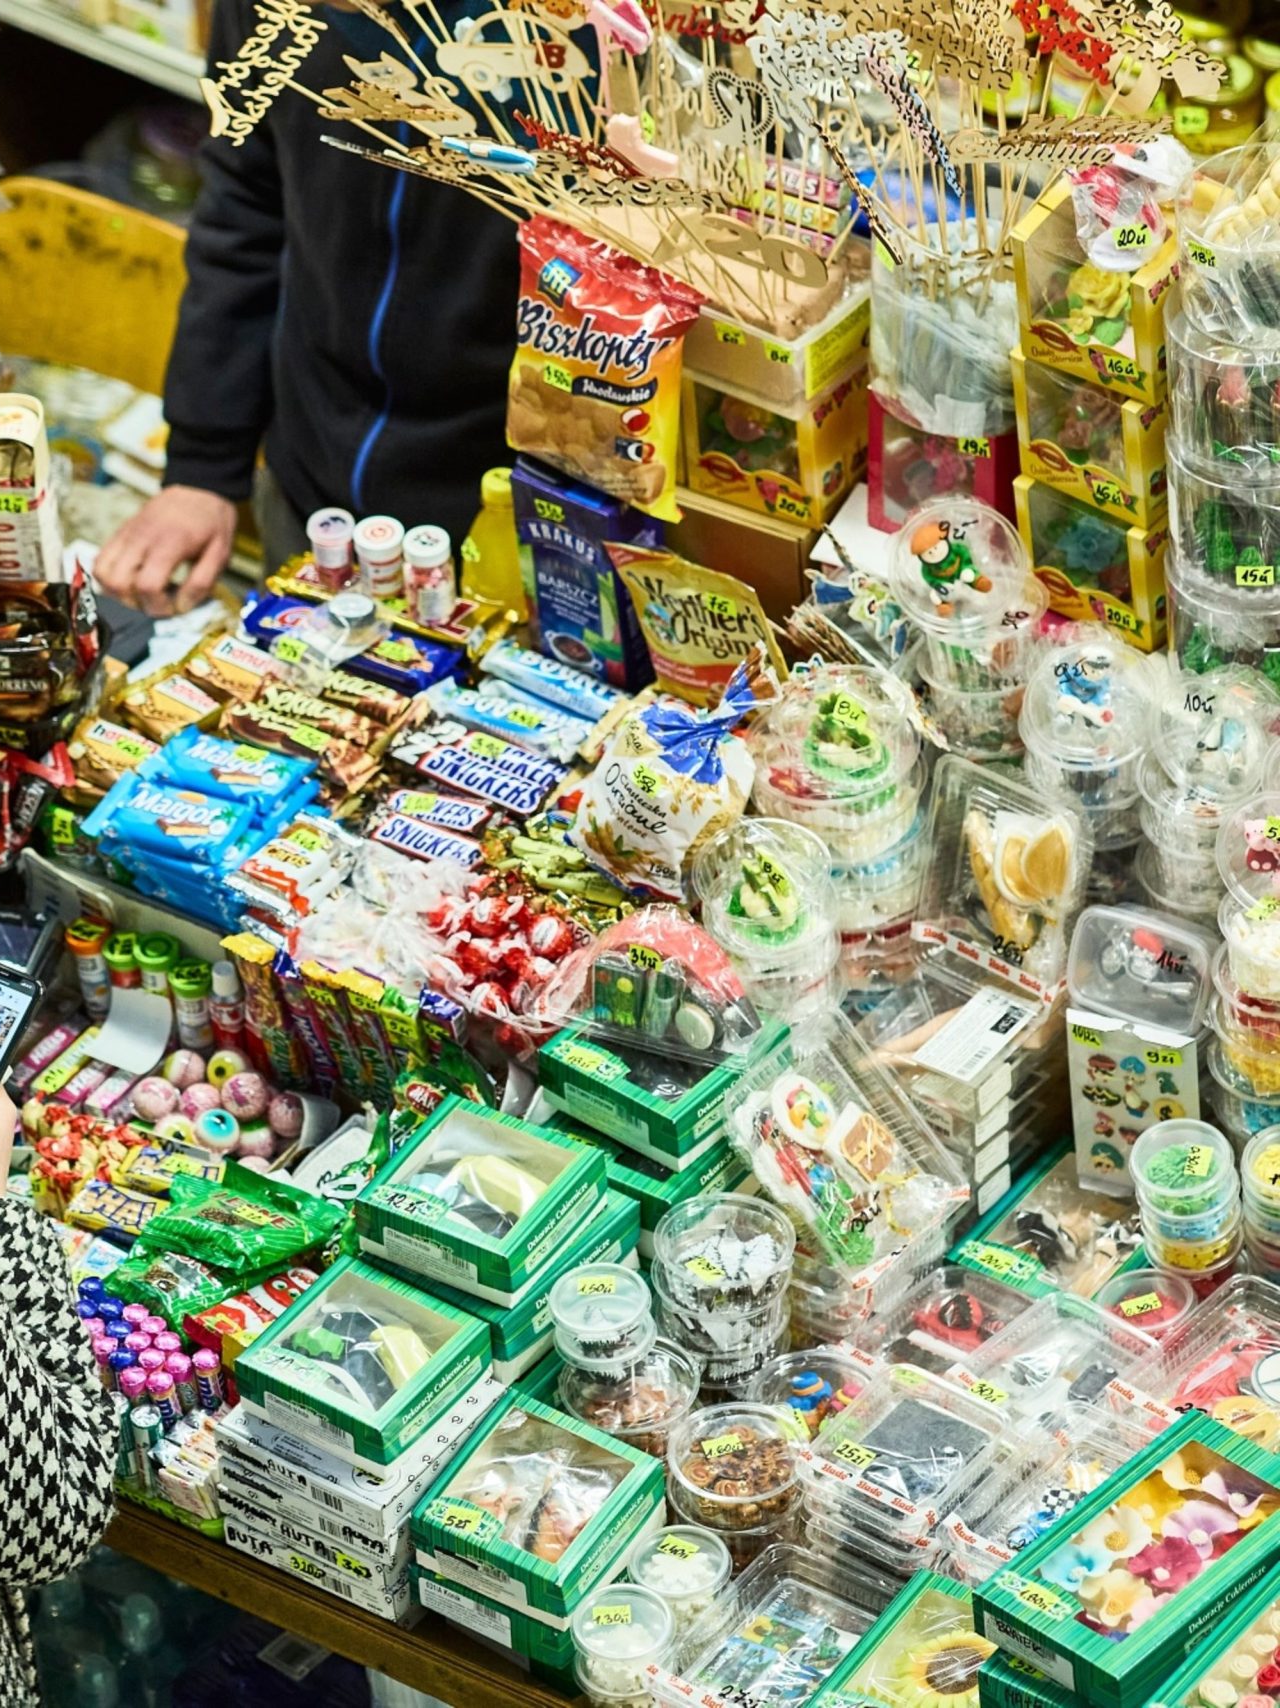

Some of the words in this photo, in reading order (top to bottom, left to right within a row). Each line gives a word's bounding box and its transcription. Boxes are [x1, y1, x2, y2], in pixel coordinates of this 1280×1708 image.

[517, 294, 673, 381] Biszkopty
[528, 521, 595, 563] KRAKUS
[537, 572, 598, 609] BARSZCZ
[131, 784, 222, 830] Margot
[527, 1218, 557, 1253] Dekoracje
[554, 1181, 590, 1222] Cukiernicze
[401, 1389, 434, 1426] Dekoracje
[431, 1354, 471, 1399] Cukiernicze
[581, 1537, 612, 1573] Dekoracje
[610, 1494, 645, 1540] Cukiernicze
[1187, 1596, 1226, 1636] Dekoracje
[1223, 1564, 1268, 1605] Cukiernicze
